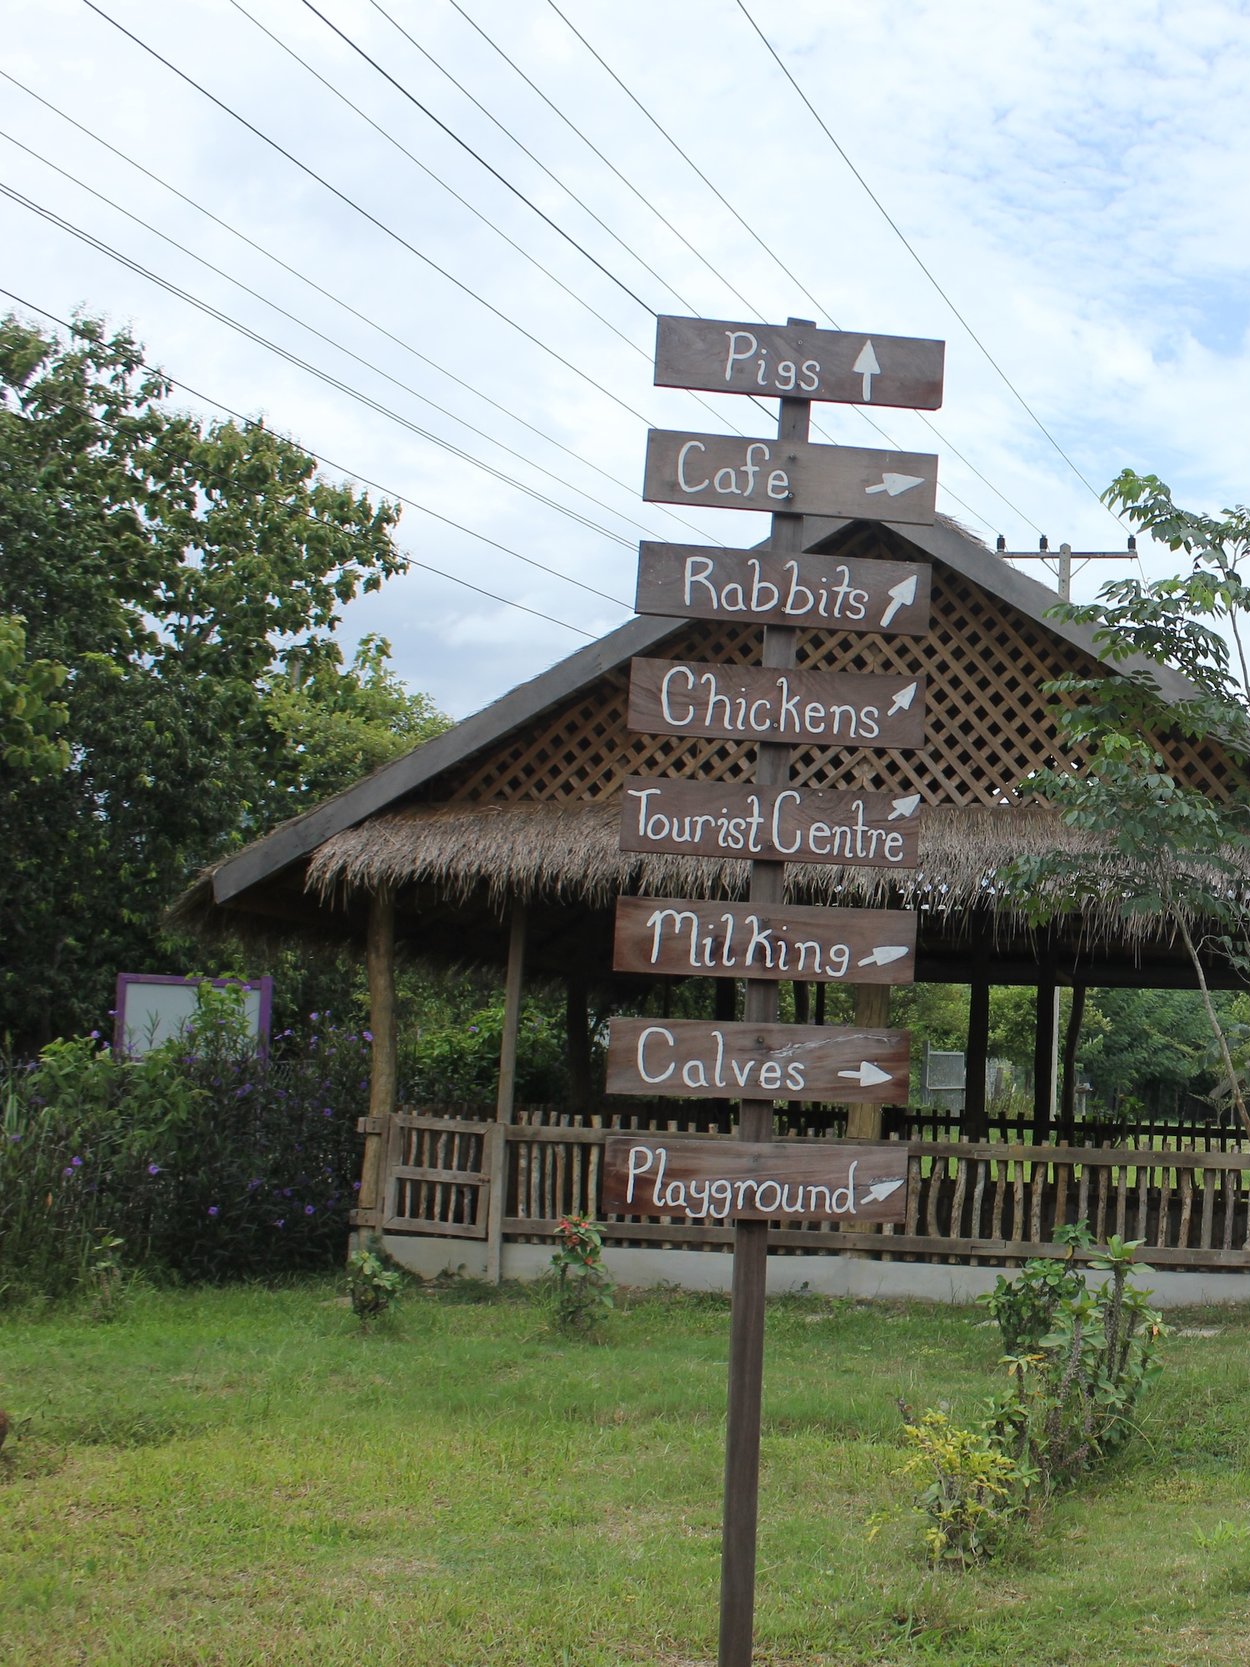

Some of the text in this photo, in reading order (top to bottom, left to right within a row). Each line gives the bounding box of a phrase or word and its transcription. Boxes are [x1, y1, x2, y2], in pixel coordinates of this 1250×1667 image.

[725, 331, 821, 391] Pigs
[678, 440, 791, 499] Cafe
[683, 556, 870, 621] Rabbits
[661, 665, 881, 739] Chickens
[627, 788, 904, 862] Tourist Centre
[646, 909, 850, 978] Milking
[637, 1026, 805, 1091] Calves
[626, 1146, 858, 1219] Playground
